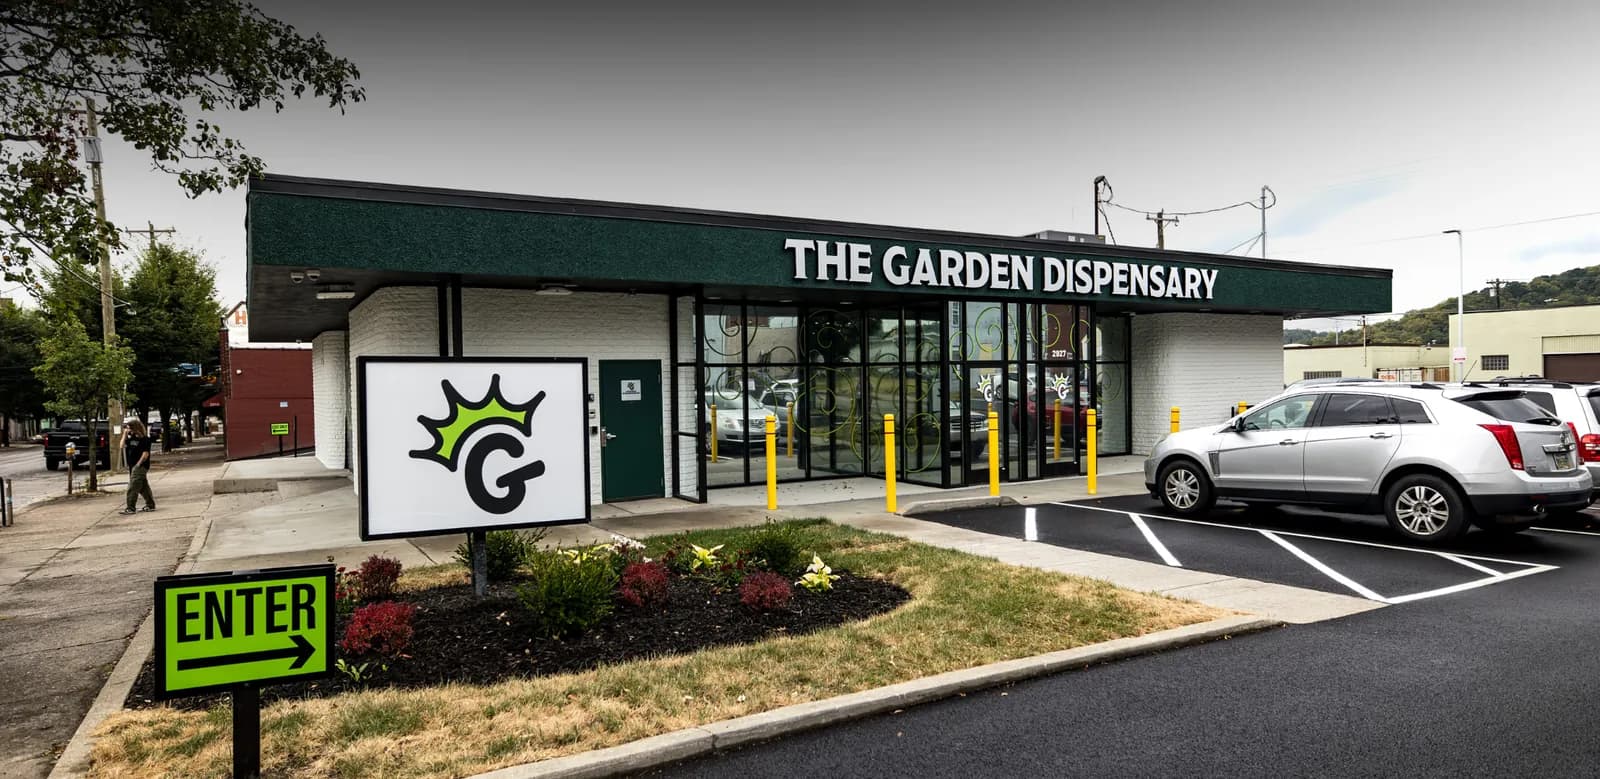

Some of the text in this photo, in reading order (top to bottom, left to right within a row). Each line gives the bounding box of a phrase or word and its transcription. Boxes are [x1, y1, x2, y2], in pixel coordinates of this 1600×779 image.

[784, 238, 1219, 299] THE GARDEN DISPENSARY
[464, 432, 546, 515] G
[177, 583, 316, 644] ENTER
